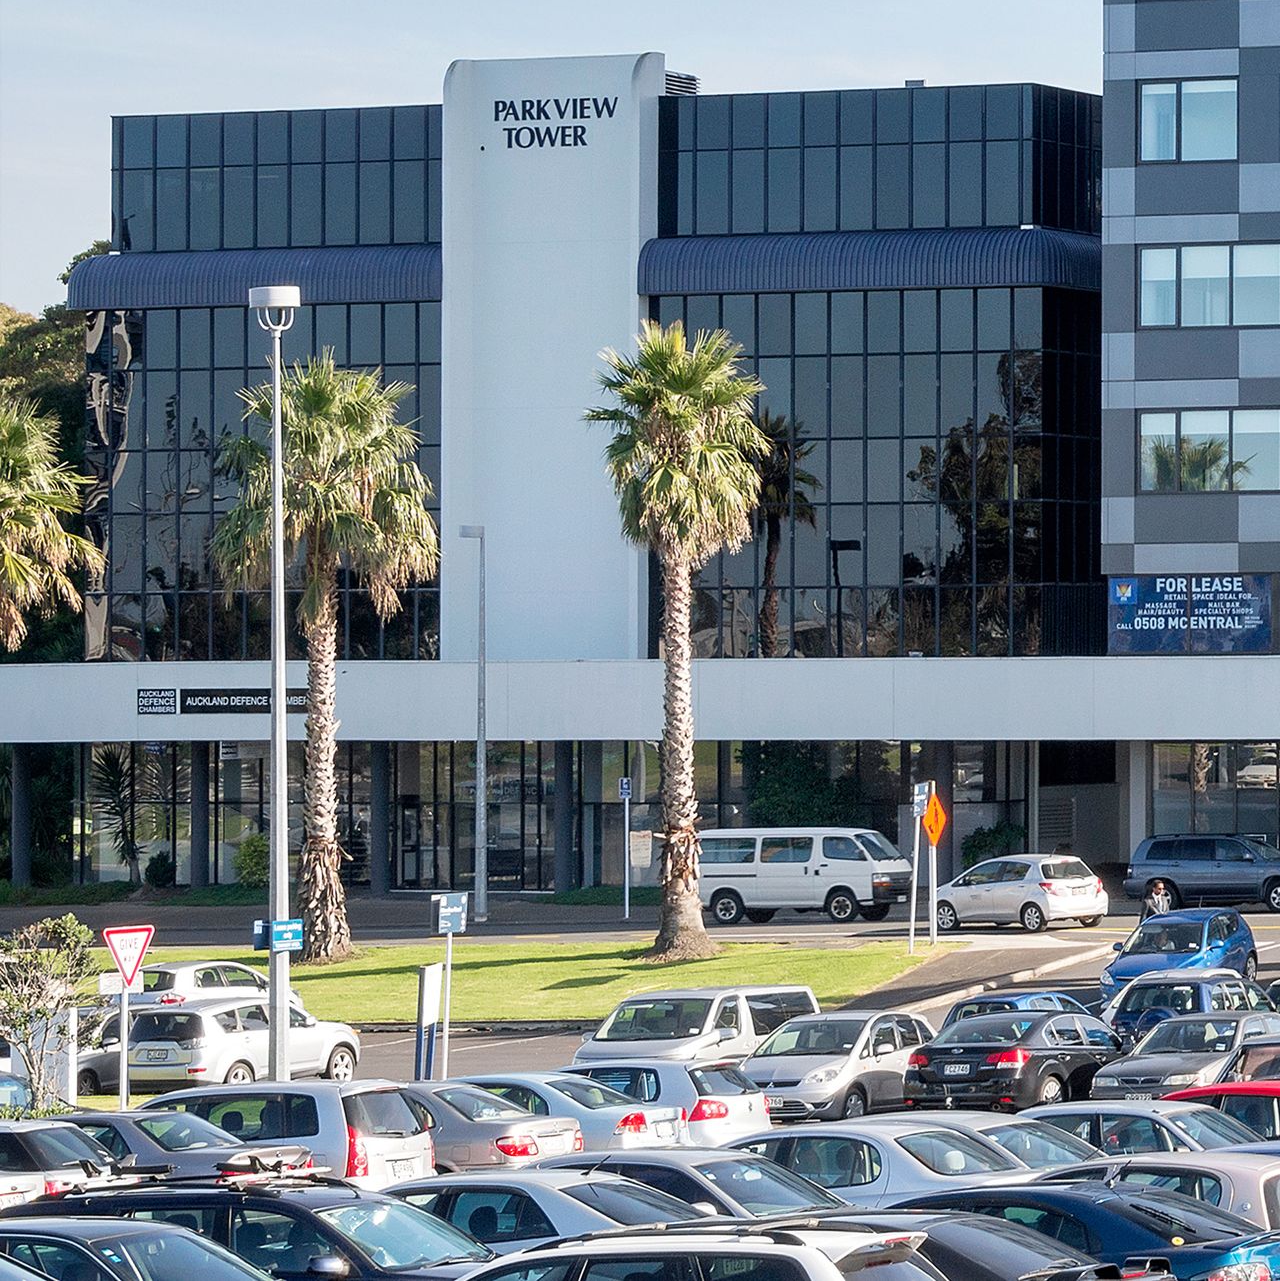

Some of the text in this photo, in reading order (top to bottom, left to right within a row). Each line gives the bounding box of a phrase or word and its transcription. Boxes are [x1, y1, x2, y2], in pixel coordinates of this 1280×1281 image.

[502, 125, 587, 148] TOWER
[1156, 577, 1243, 592] FOR LEASE
[1134, 617, 1165, 630] 0508
[139, 698, 175, 706] DEFENCE
[186, 695, 307, 706] AUCKLAND DEFENCE CMBER
[120, 937, 138, 950] GIVE
